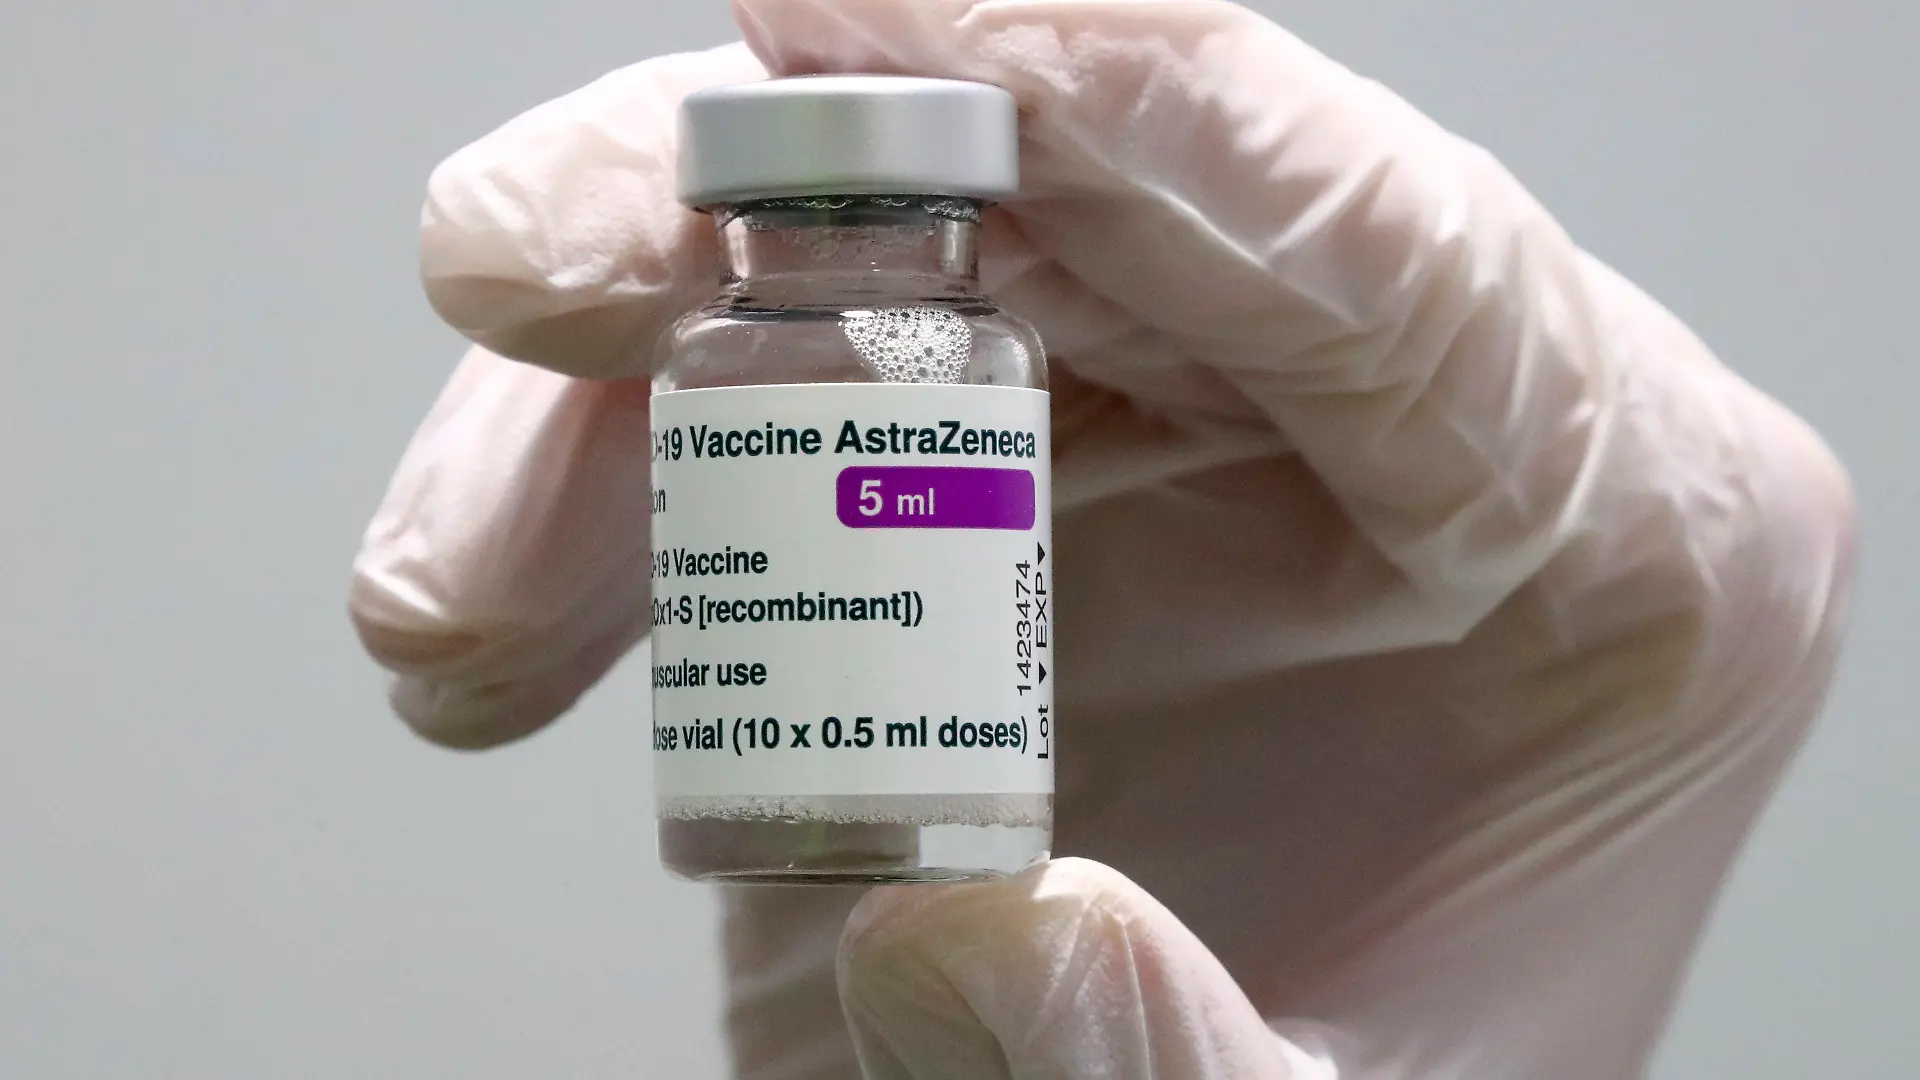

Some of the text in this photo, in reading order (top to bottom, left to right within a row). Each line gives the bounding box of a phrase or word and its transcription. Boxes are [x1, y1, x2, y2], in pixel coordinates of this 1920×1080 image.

[689, 421, 822, 458] Vaccine
[834, 420, 1036, 458] AstraZeneca
[858, 479, 935, 516] 5 ml
[673, 546, 769, 576] Vaccine
[699, 591, 923, 630] [recombinant])
[1015, 560, 1032, 696] 1423474
[652, 657, 767, 689] uscular use
[1035, 571, 1049, 759] Lot EXP
[682, 717, 723, 750] vial
[732, 717, 780, 756] (10
[790, 724, 811, 748] x
[821, 716, 875, 749] 0.5
[886, 716, 927, 748] ml
[938, 716, 1028, 755] doses)
